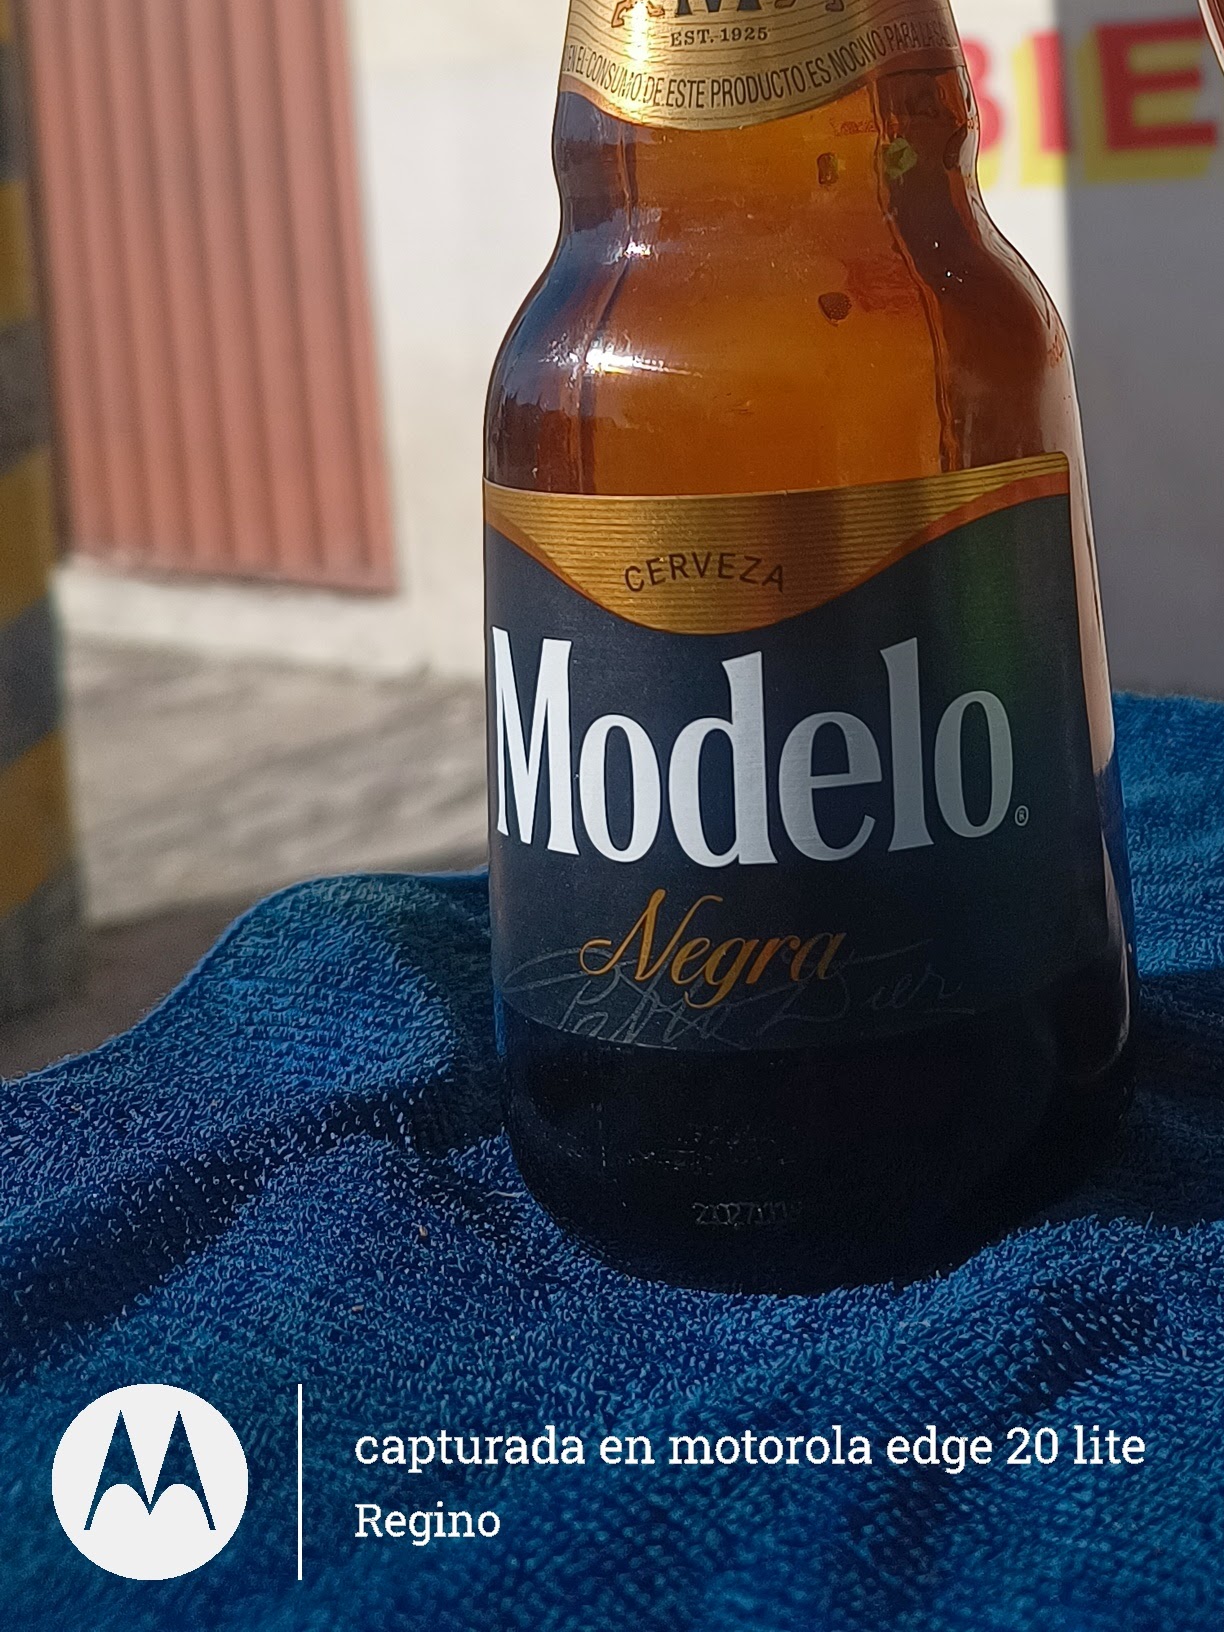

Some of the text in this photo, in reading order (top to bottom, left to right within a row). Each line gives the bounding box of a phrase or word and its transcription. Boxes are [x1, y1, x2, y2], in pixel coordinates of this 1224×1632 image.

[586, 51, 642, 101] CONSUMO
[643, 76, 664, 106] DE
[666, 79, 705, 108] ESTE
[710, 65, 807, 109] PRODUCTO
[806, 57, 832, 88] ES
[828, 29, 887, 79] NOCIVO
[885, 21, 921, 52] PARA
[670, 26, 769, 48] EST. 1925
[623, 551, 787, 594] CERVEZA
[490, 625, 1015, 867] Modelo
[579, 889, 846, 1009] Negra
